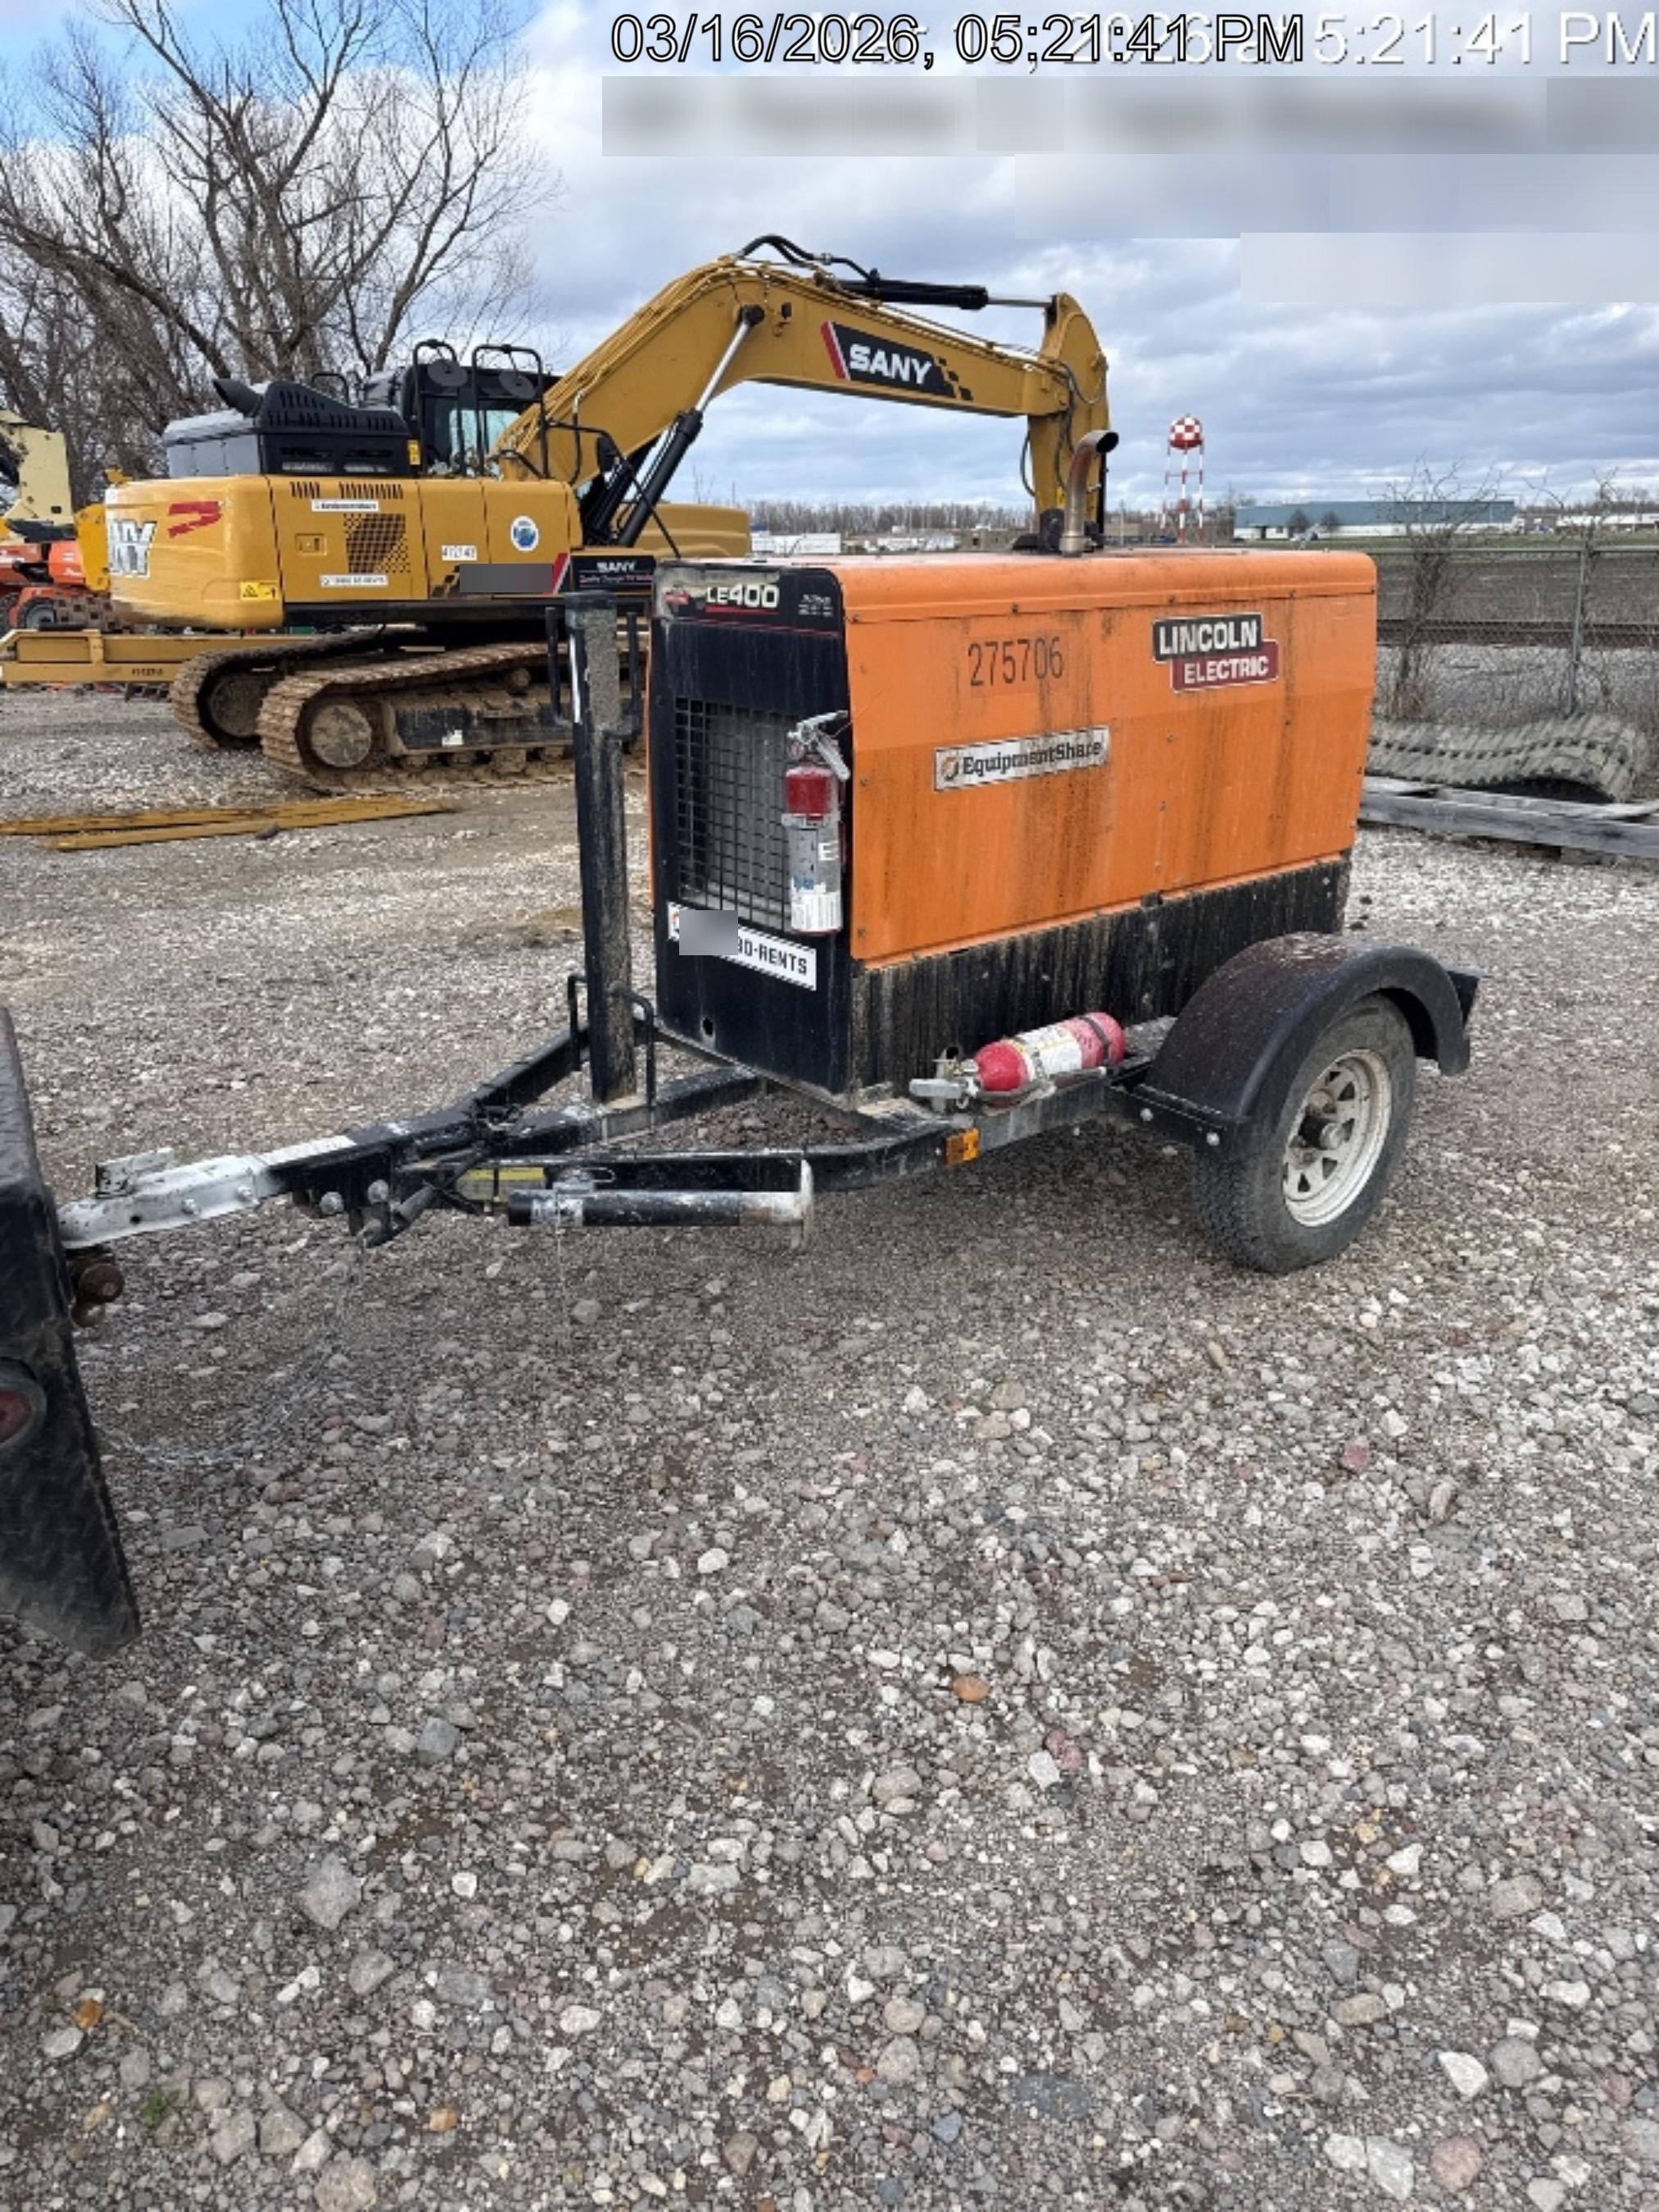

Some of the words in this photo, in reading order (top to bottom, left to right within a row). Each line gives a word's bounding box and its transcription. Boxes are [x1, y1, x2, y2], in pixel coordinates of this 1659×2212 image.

[849, 343, 932, 385] SANY
[706, 584, 779, 609] LE400
[1158, 620, 1258, 655] LINCOLN
[968, 636, 1064, 687] 275706
[1184, 656, 1269, 685] ELECTRIC
[962, 741, 1102, 777] EquipmentShare
